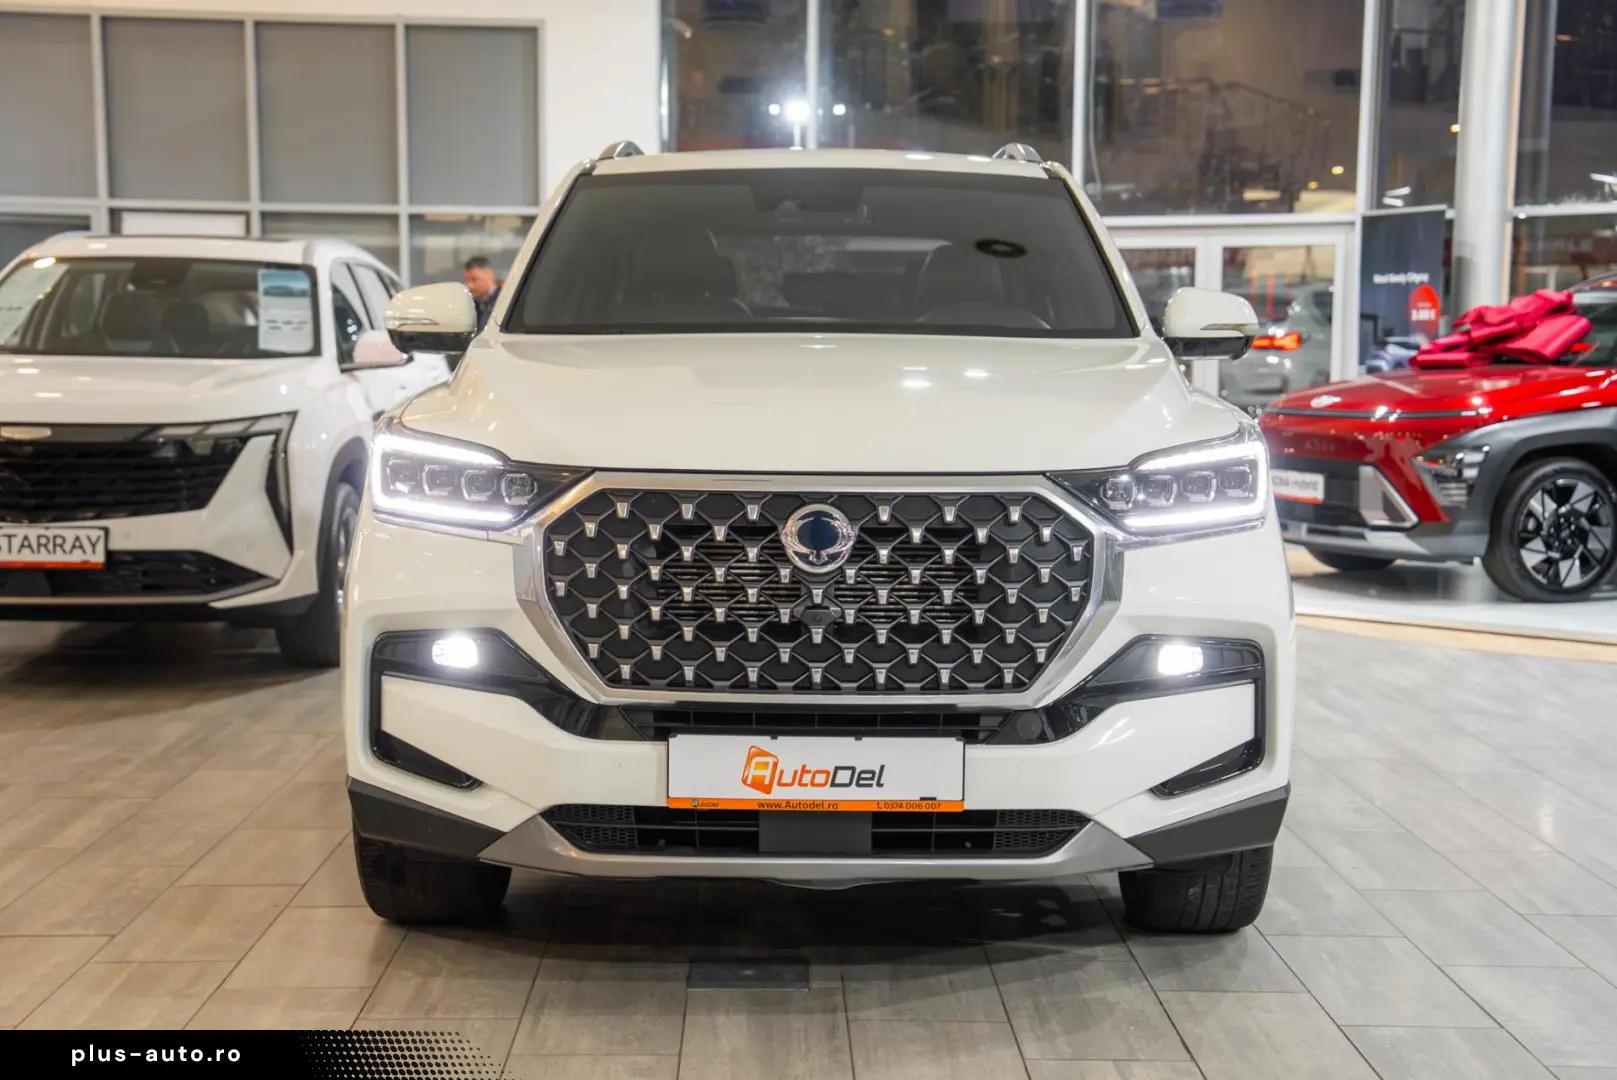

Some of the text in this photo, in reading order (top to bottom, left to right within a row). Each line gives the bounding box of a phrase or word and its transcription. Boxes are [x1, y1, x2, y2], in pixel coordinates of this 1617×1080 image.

[0, 533, 102, 555] TARRAY
[744, 755, 886, 788] AutoDel
[757, 801, 839, 810] www.Autodel.ro
[883, 802, 941, 810] 0374 006 007
